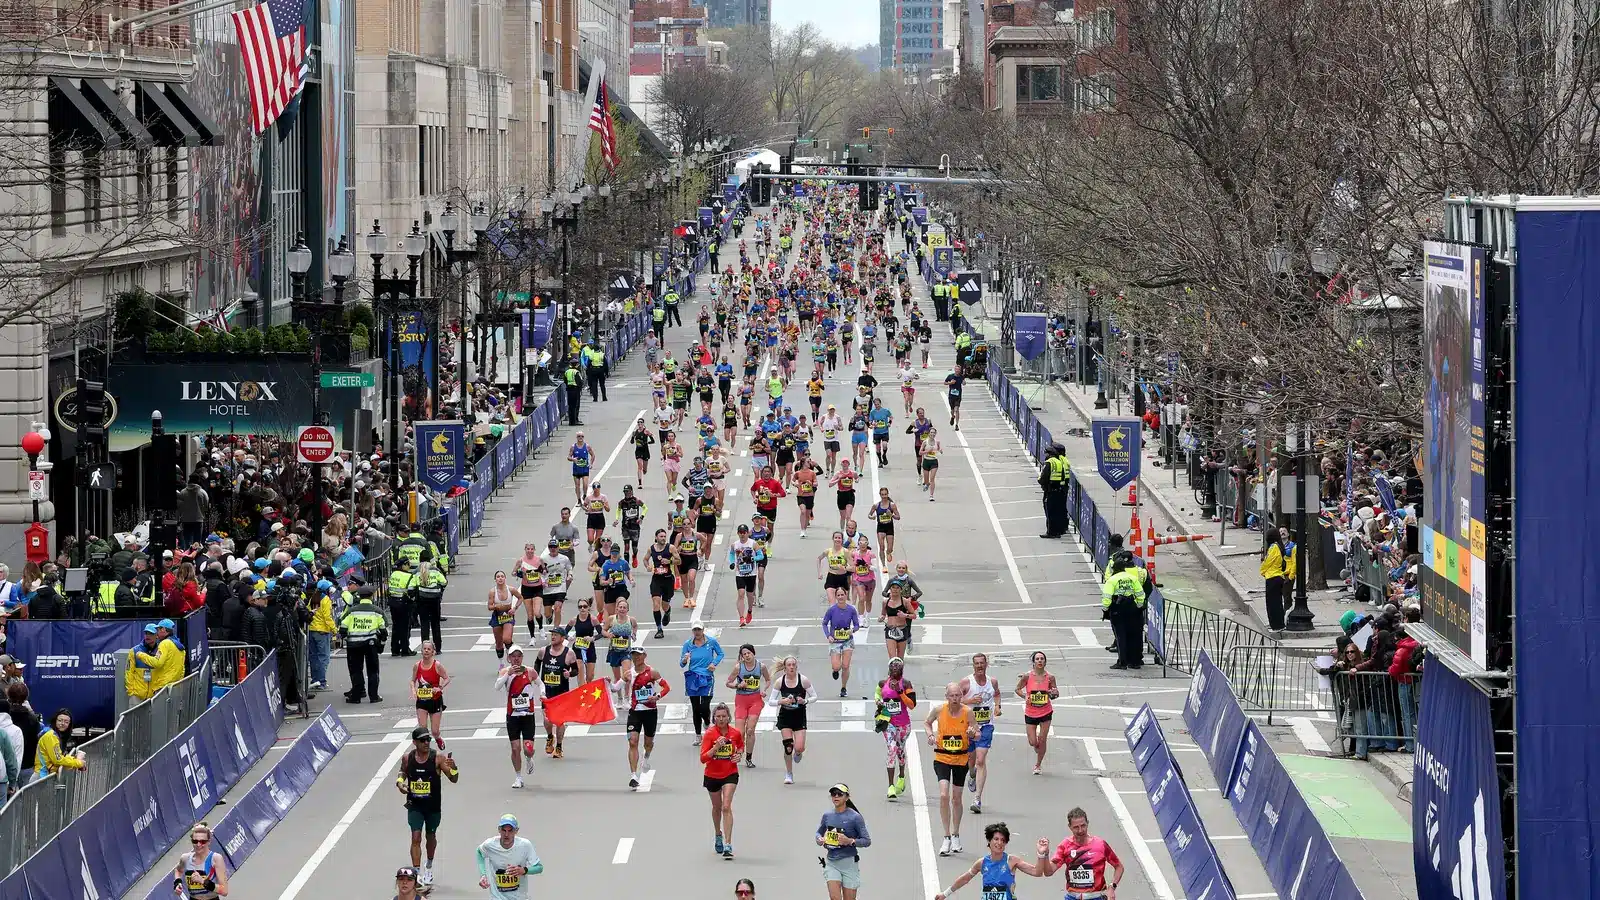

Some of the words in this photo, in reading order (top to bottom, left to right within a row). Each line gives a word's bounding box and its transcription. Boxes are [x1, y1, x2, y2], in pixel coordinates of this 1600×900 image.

[931, 237, 943, 245] 26
[332, 376, 361, 387] EXETER
[209, 405, 250, 416] HOTEL
[35, 655, 80, 668] ESPN
[943, 739, 961, 748] 21212
[1072, 870, 1089, 880] 9335
